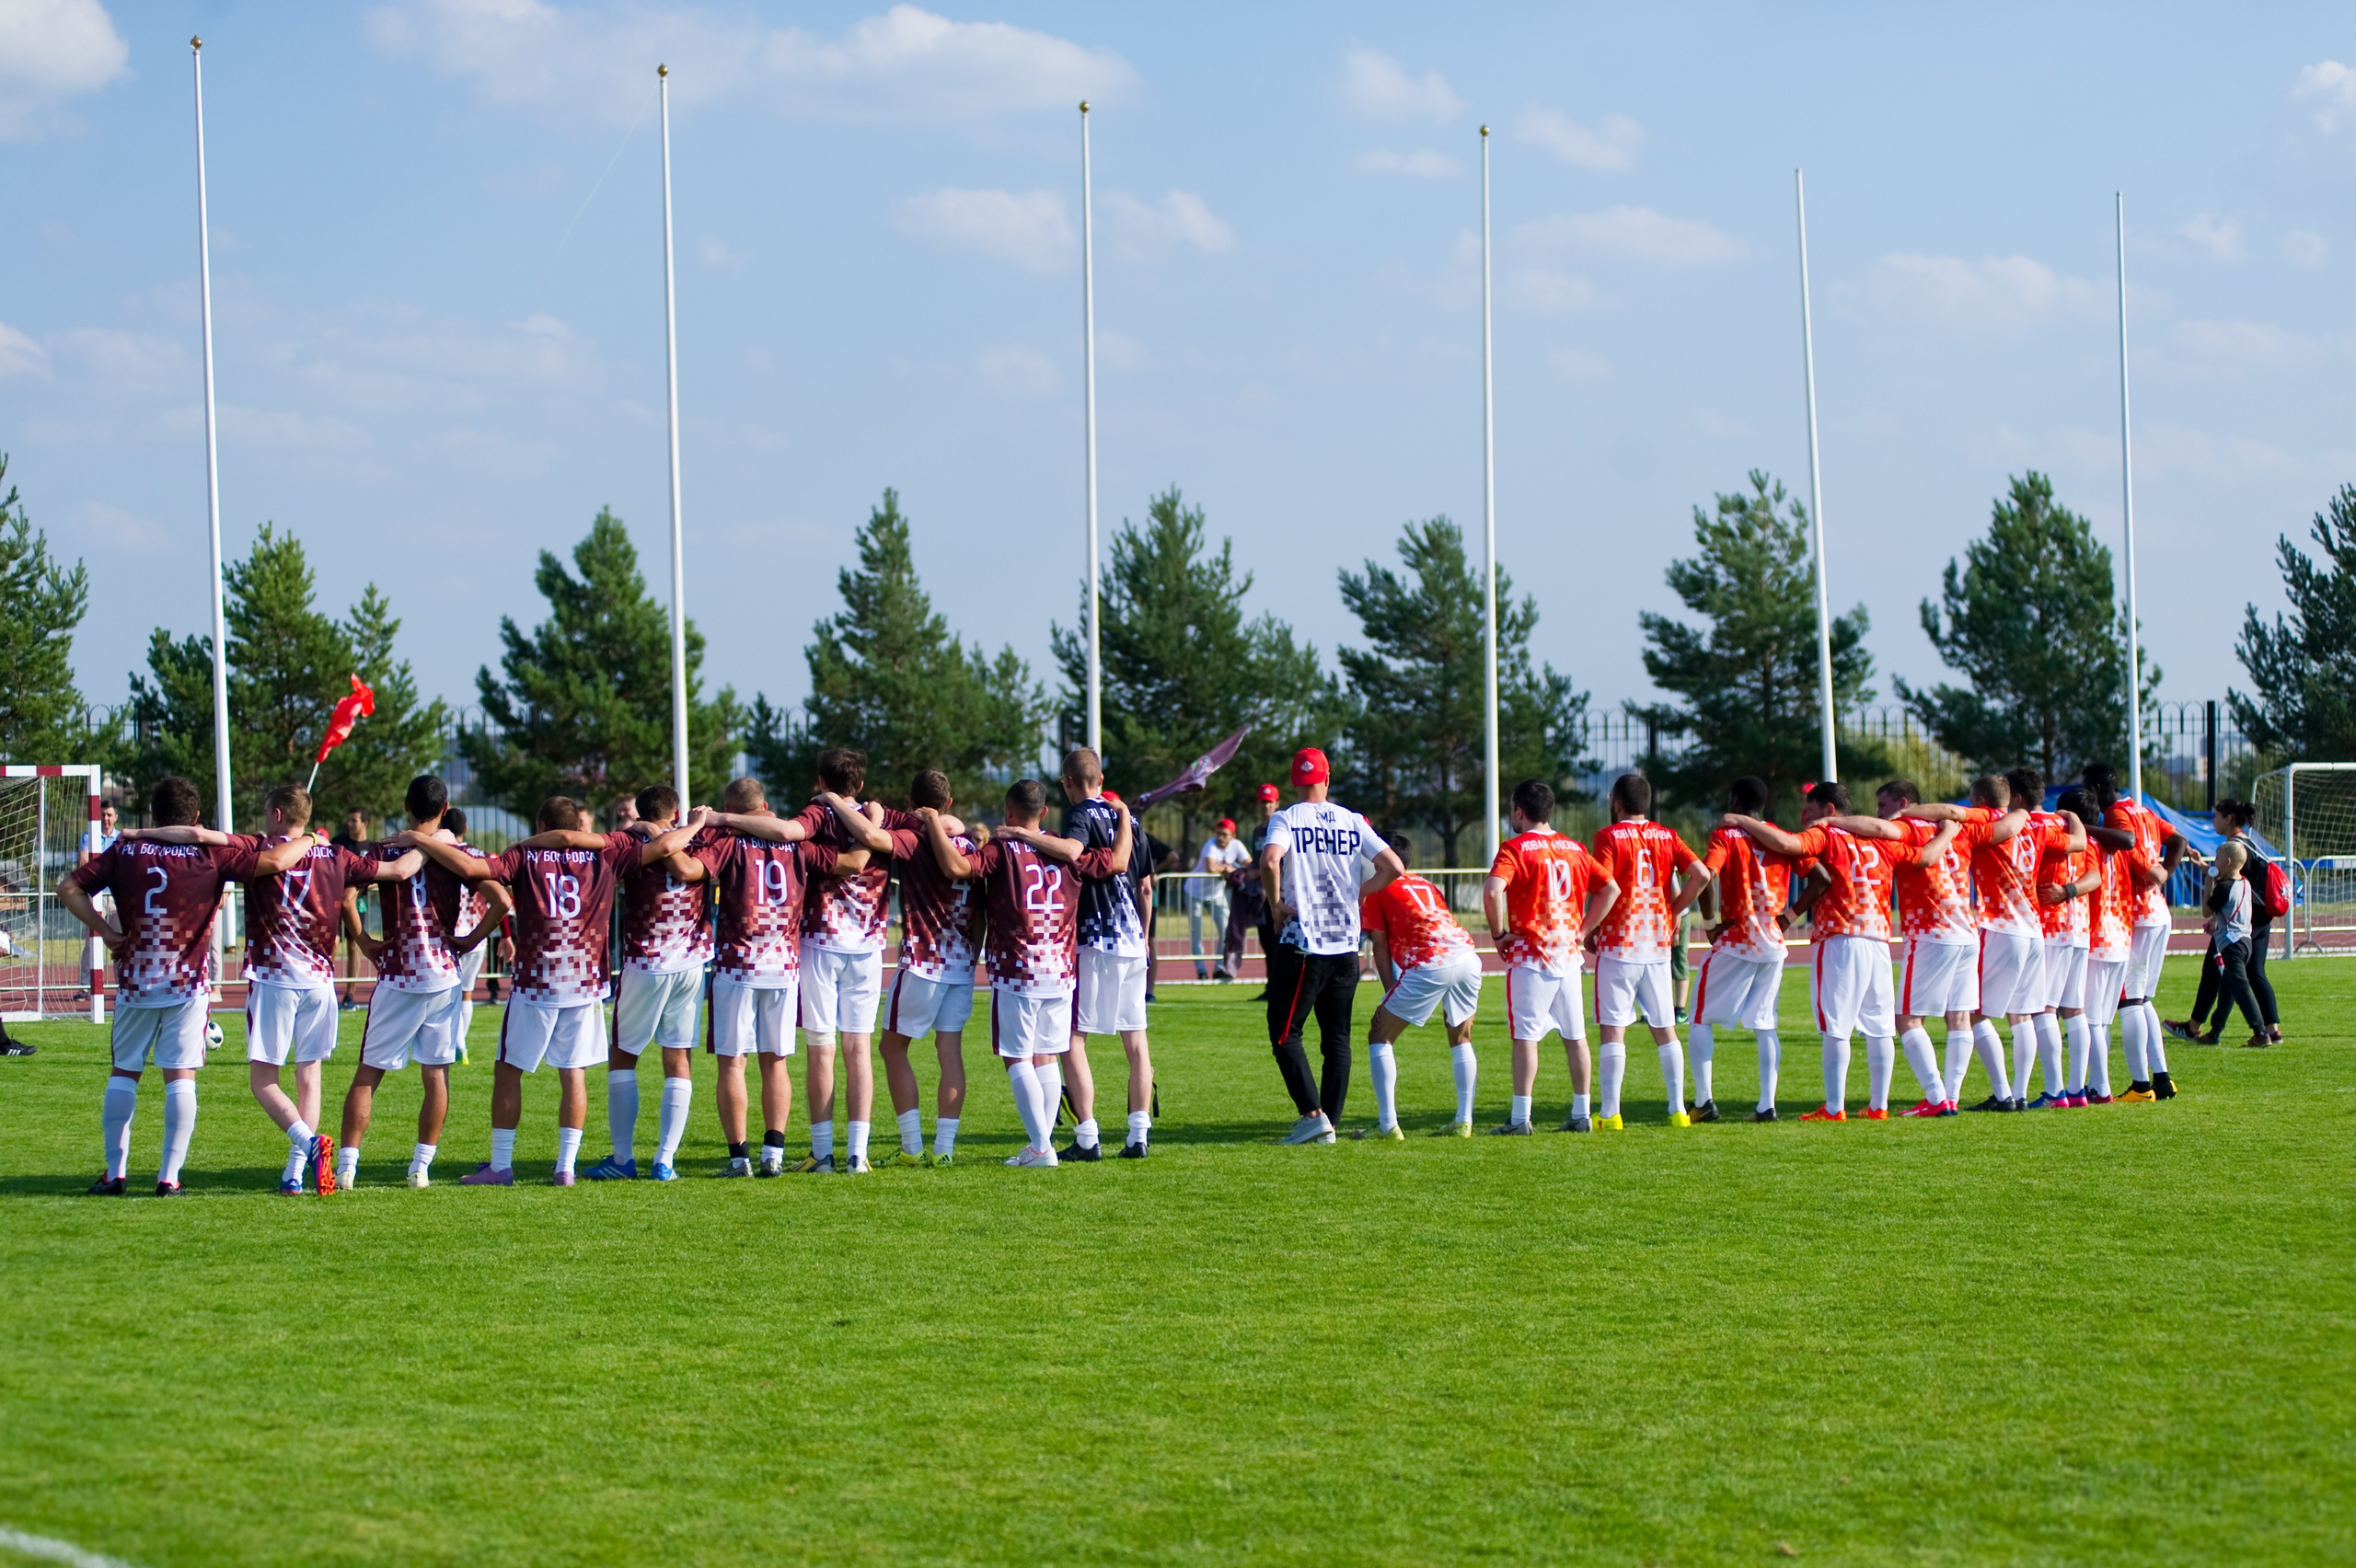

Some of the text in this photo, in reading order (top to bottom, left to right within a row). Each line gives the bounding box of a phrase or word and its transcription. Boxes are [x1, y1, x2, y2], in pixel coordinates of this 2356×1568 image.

[121, 843, 200, 858] РЦ БОГОРОДСК
[1291, 826, 1360, 856] ТРЕНЕР
[1520, 839, 1550, 852] НОВАЯ
[2011, 834, 2036, 873] 18
[755, 859, 788, 905] 19
[1544, 858, 1572, 902] 10
[1636, 848, 1655, 888] 6
[1847, 843, 1882, 885] 22
[144, 866, 168, 915] 2
[281, 868, 313, 911] 17
[545, 872, 582, 918] 18
[1025, 863, 1065, 910] 22
[1402, 884, 1437, 912] 17
